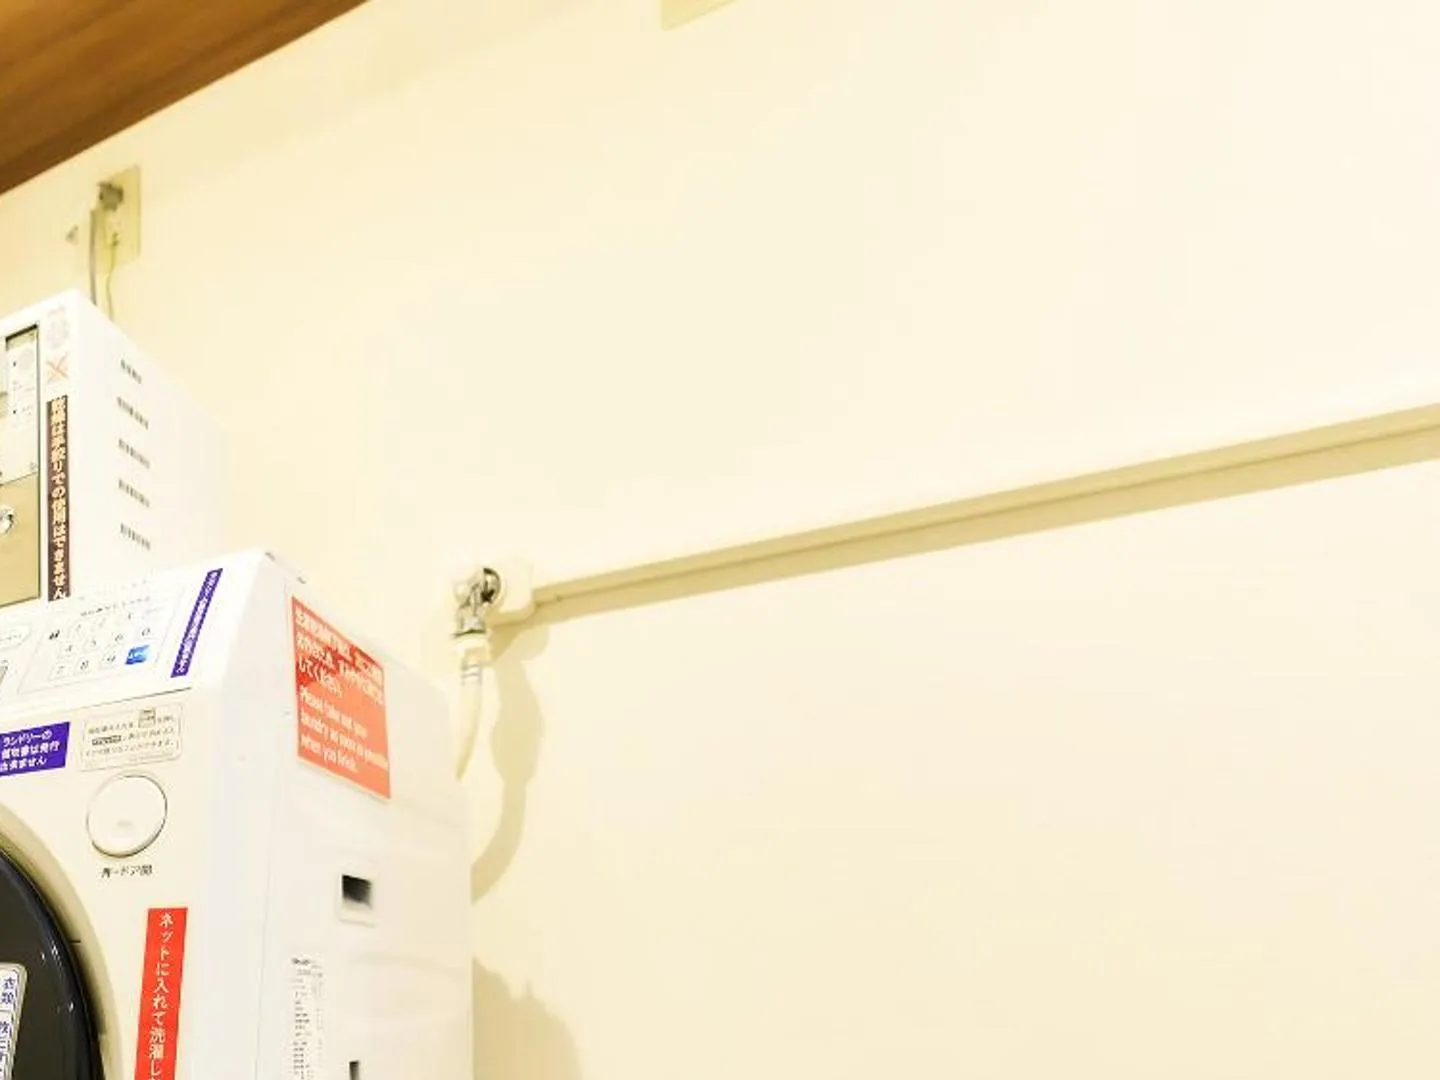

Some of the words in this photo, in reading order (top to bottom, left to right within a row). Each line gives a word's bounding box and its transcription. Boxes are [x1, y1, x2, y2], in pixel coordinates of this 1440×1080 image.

[3, 729, 53, 748] ランドリーの
